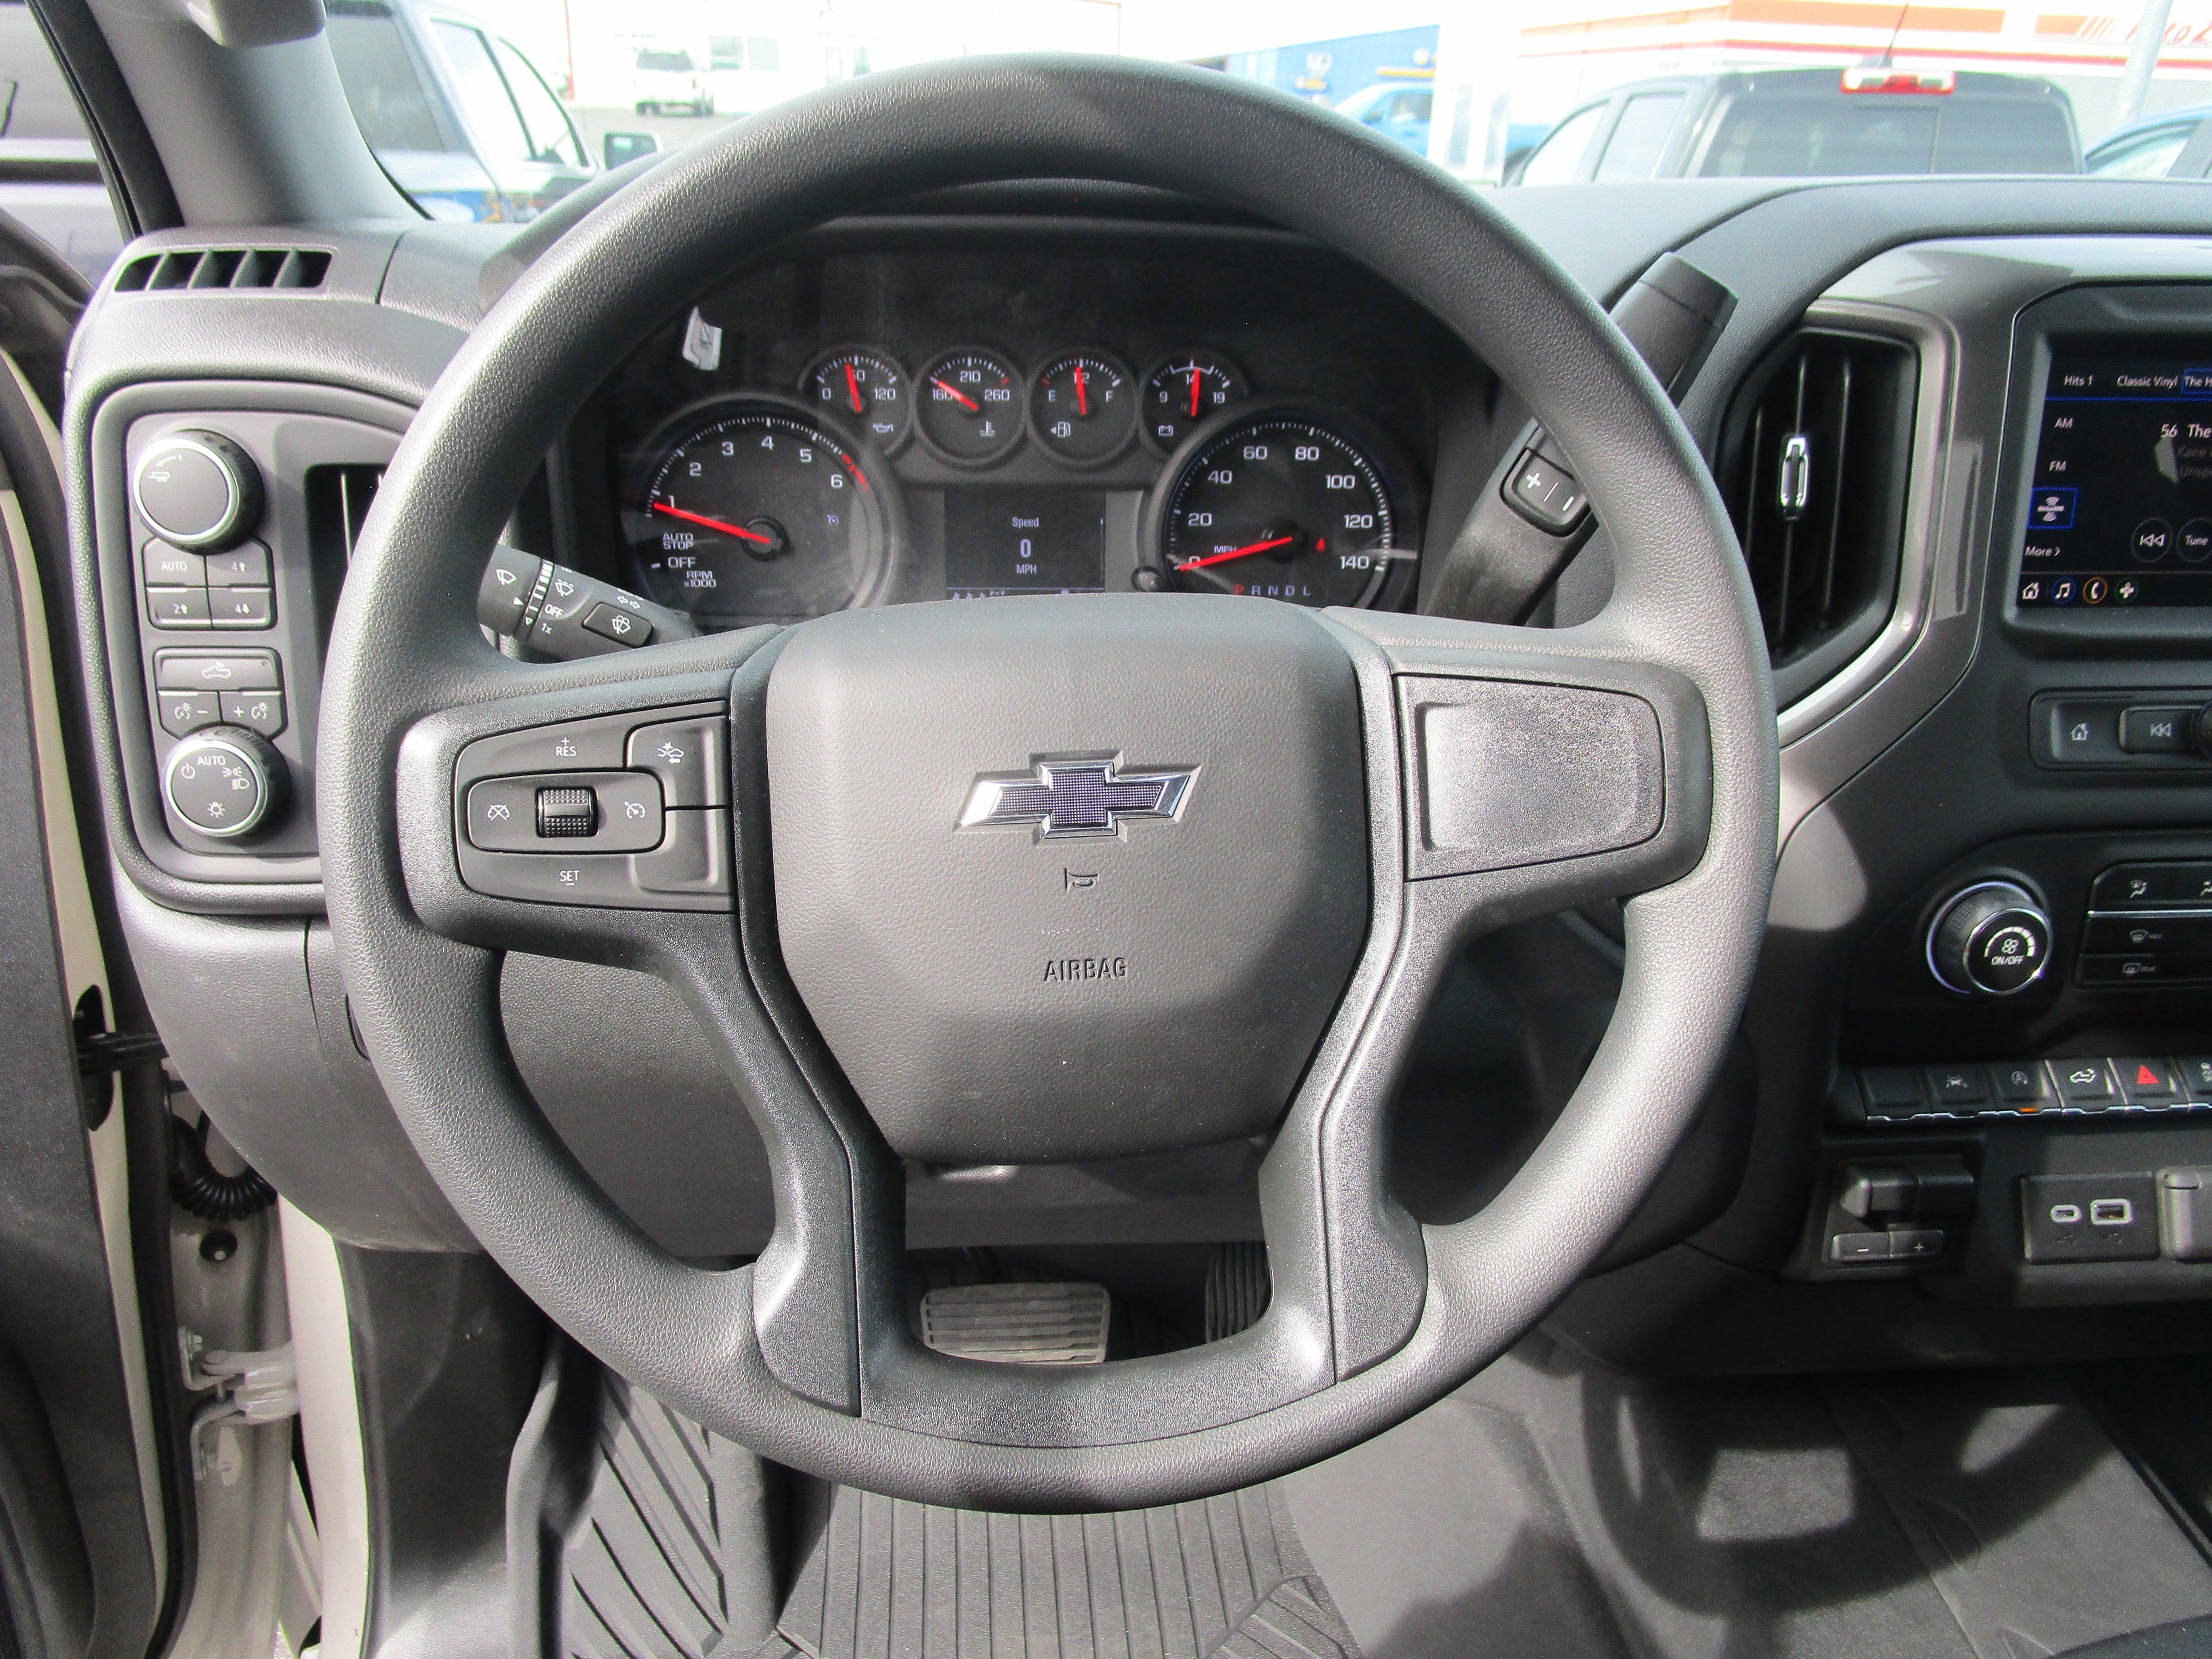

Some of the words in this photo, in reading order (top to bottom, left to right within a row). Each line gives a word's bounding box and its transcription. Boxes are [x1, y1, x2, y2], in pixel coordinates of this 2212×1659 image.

[960, 371, 981, 383] 210
[2064, 374, 2084, 386] Hits
[2088, 374, 2094, 386] 1
[2117, 374, 2152, 387] Classic
[2153, 375, 2179, 390] Vinyl
[2185, 375, 2202, 387] The
[822, 387, 832, 400] 0
[874, 387, 896, 400] 120
[932, 388, 953, 401] 160
[984, 389, 1010, 401] 260
[1048, 390, 1056, 401] E
[1106, 390, 1114, 403] F
[1159, 391, 1168, 404] 9
[1213, 391, 1226, 404] 19
[2054, 417, 2074, 429] AM
[2160, 423, 2179, 438] 56
[2187, 423, 2212, 438] The
[721, 441, 734, 456] 3
[761, 436, 774, 450] 4
[799, 449, 812, 463] 5
[1243, 446, 1268, 460] 60
[1295, 446, 1319, 461] 80
[689, 462, 702, 477] 2
[2048, 460, 2067, 472] FM
[830, 474, 843, 489] 6
[1208, 470, 1233, 484] 40
[1326, 474, 1355, 489] 100
[668, 495, 675, 509] 1
[1012, 517, 1039, 529] Speed
[1188, 512, 1212, 526] 20
[1344, 514, 1373, 529] 120
[662, 532, 693, 541] AUTO
[2185, 535, 2209, 547] Tune
[663, 541, 693, 550] STOP
[1020, 539, 1031, 558] 0
[2025, 546, 2053, 557] More
[161, 561, 188, 572] AUTO
[668, 556, 696, 568] OFF
[1340, 556, 1370, 570] 140
[686, 571, 713, 579] RPM
[1016, 564, 1037, 574] MPH
[684, 579, 717, 589] x1000
[1235, 584, 1244, 595] P
[1251, 585, 1261, 596] R
[1268, 585, 1278, 596] N
[1285, 585, 1295, 596] D
[1303, 585, 1311, 596] L
[544, 604, 564, 618] OFF
[541, 623, 553, 635] 1x
[556, 746, 577, 757] RES
[198, 755, 226, 766] AUTO
[559, 870, 580, 881] SET
[1991, 955, 2024, 966] ON/OFF
[1044, 957, 1128, 982] AIRBAG
